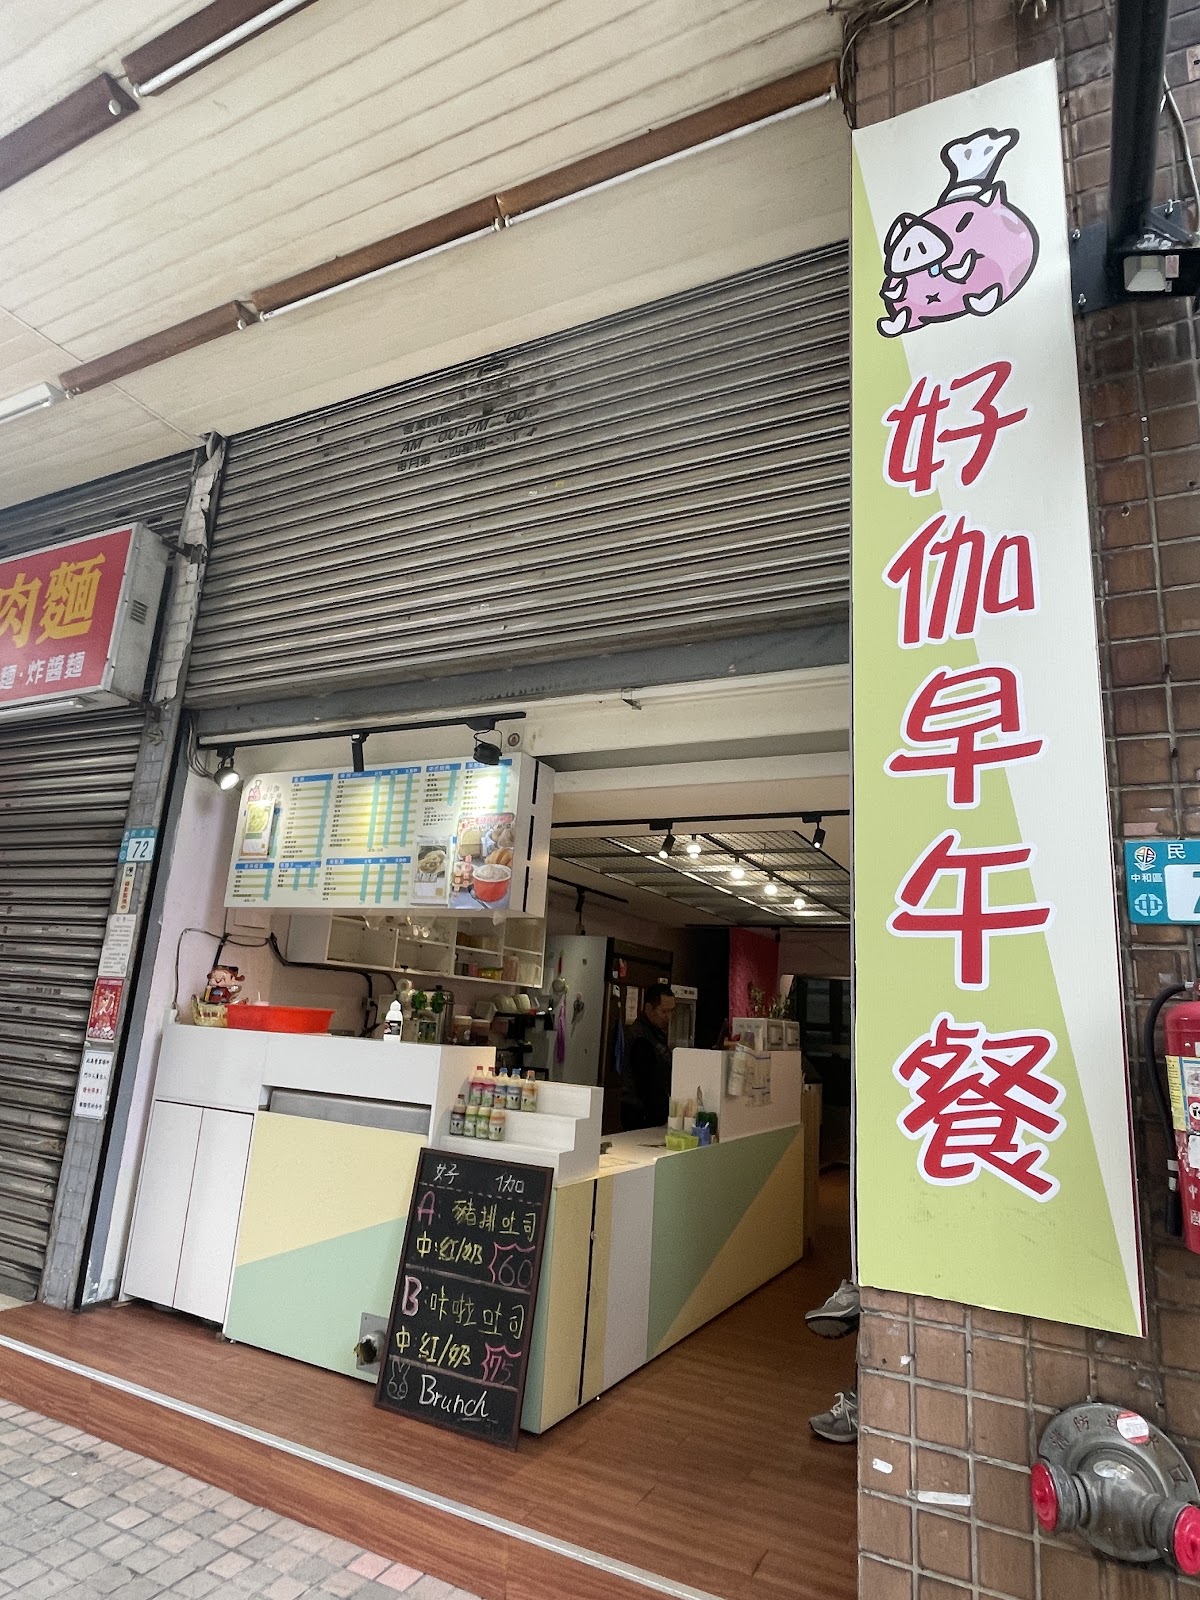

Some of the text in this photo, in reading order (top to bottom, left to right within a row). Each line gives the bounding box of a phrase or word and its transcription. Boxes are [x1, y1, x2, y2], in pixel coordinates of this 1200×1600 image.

[885, 358, 1063, 1197] 好伽早午餐
[133, 840, 149, 859] 72
[1130, 872, 1163, 883] 中和區
[434, 1163, 459, 1184] 好
[498, 1254, 534, 1288] 60
[419, 1374, 489, 1418] Brunch
